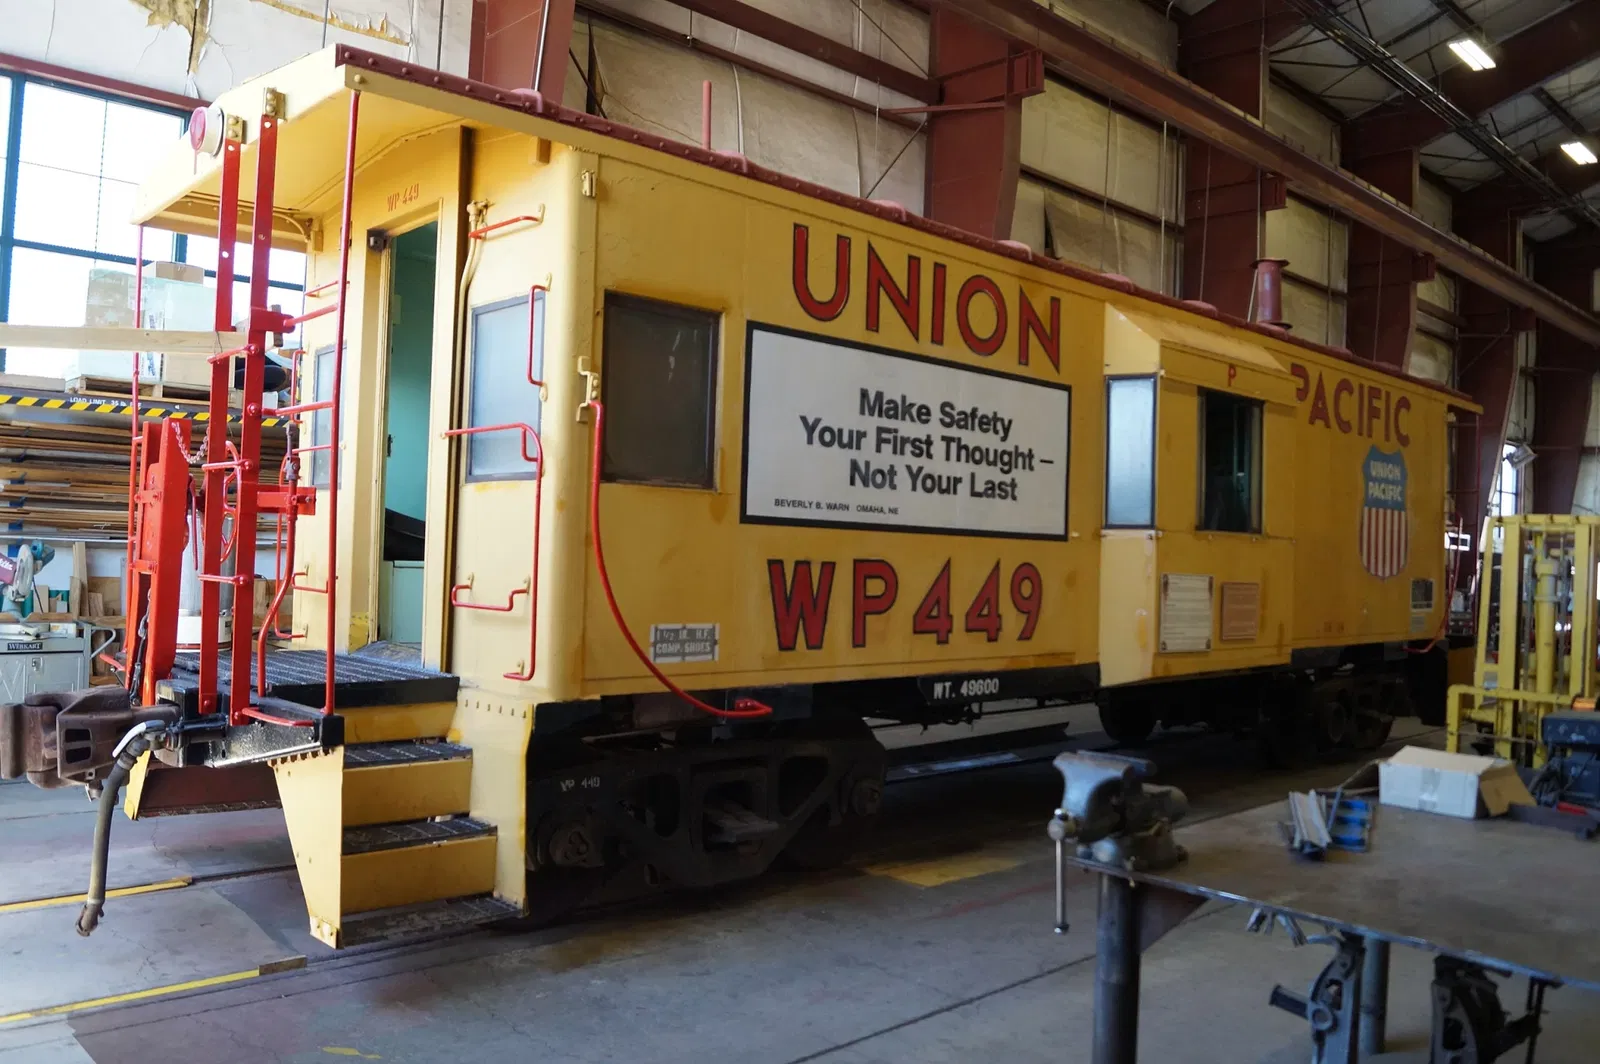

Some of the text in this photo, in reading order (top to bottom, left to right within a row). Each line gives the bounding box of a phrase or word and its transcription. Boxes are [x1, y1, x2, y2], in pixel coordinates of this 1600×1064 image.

[402, 183, 419, 204] 449
[792, 222, 1061, 375] UNION
[1227, 363, 1237, 387] P
[858, 387, 1013, 442] Make Safety
[799, 415, 867, 450] Your
[874, 426, 934, 460] First
[940, 435, 1035, 475] Thought
[849, 458, 1018, 501] Not Your Last
[1370, 460, 1401, 481] UNION
[1368, 481, 1403, 502] PACIFIC
[774, 498, 813, 509] BEVERLY
[826, 503, 850, 512] WARN
[856, 504, 887, 515] OMAHA,
[888, 507, 899, 515] NE
[767, 557, 1043, 652] WP 449
[960, 678, 1000, 696] 49600
